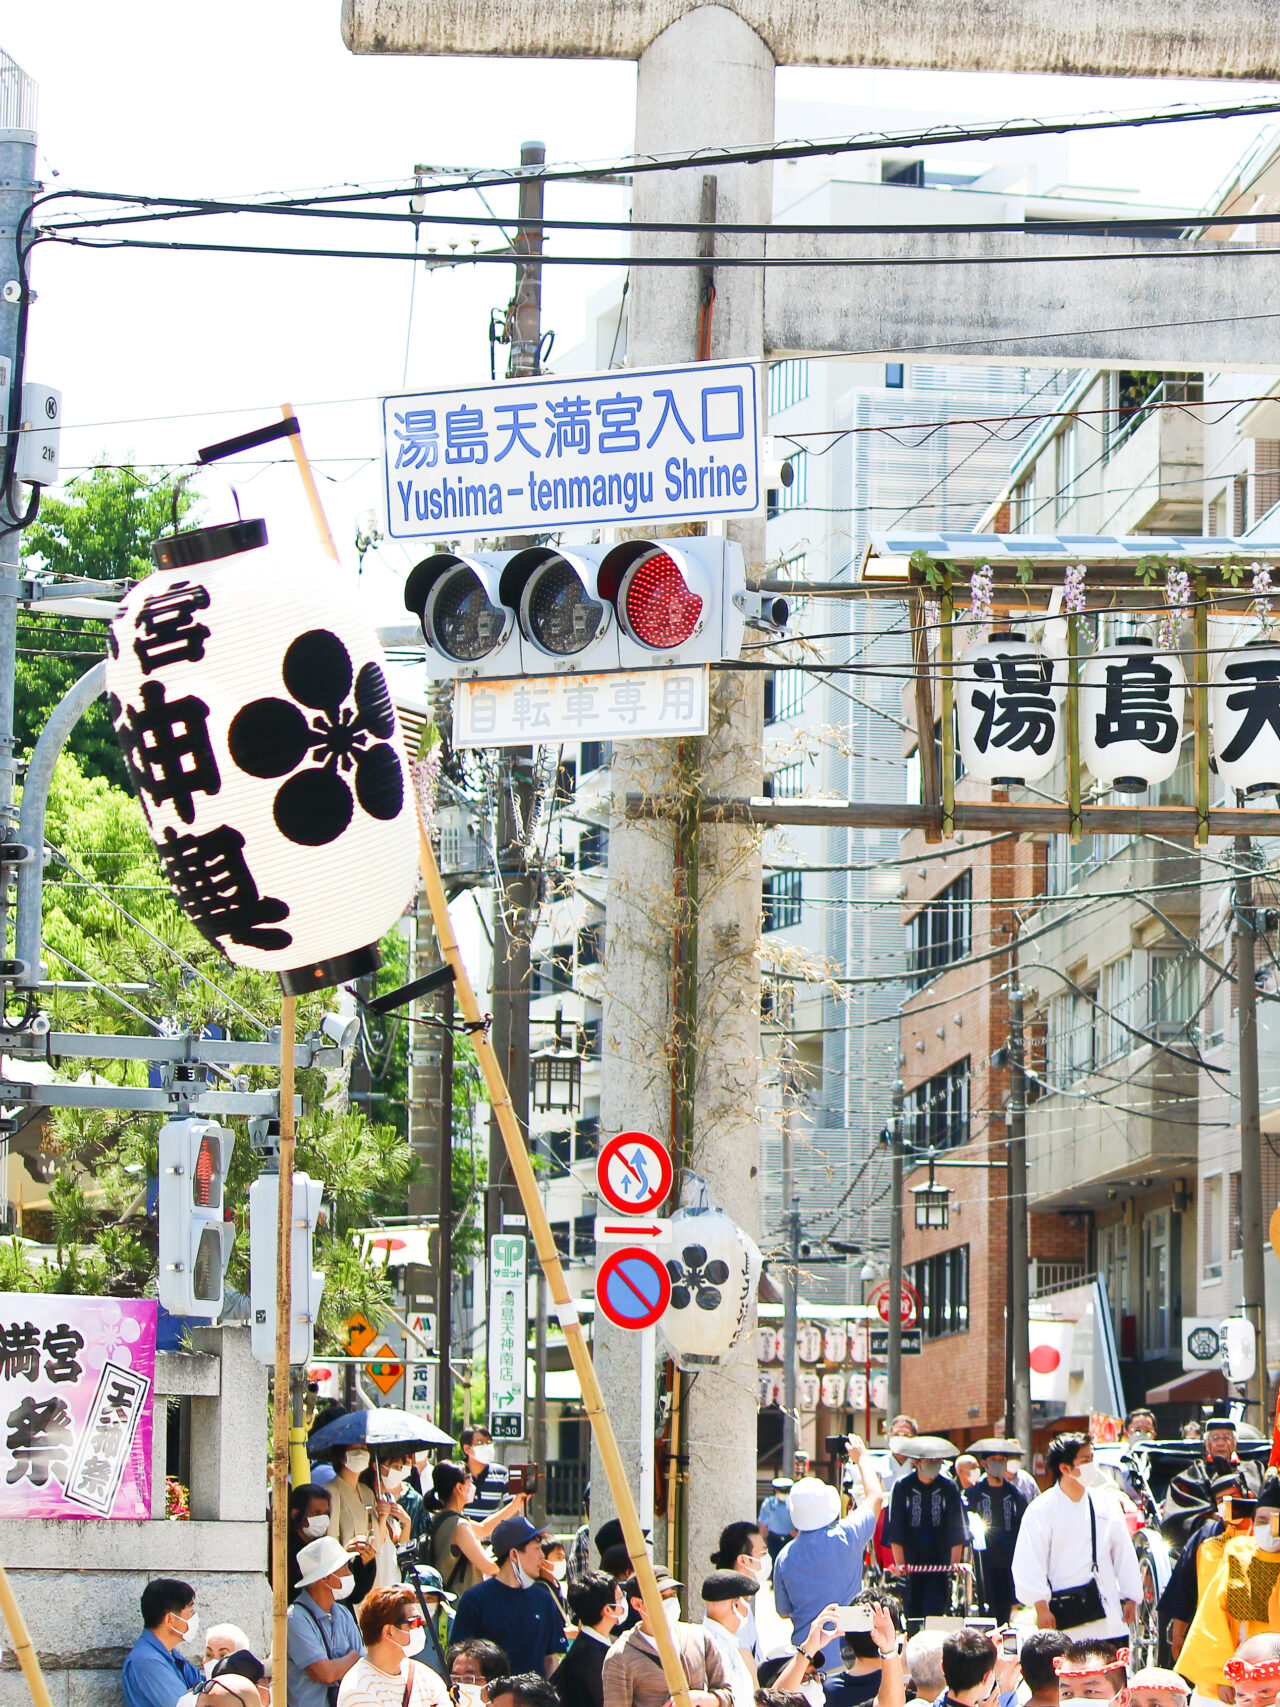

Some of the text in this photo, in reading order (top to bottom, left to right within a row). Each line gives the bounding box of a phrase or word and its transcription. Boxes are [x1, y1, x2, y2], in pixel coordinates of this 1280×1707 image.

[393, 383, 745, 471] 湯島天満宮入口
[664, 455, 748, 503] Shrine
[469, 676, 695, 734] 自転車専用
[494, 1267, 522, 1278] サミット
[881, 1298, 910, 1315] 消栓
[500, 1290, 515, 1382] 湯島天神南店
[6, 1396, 75, 1487] 祭
[495, 1427, 517, 1435] 3-30
